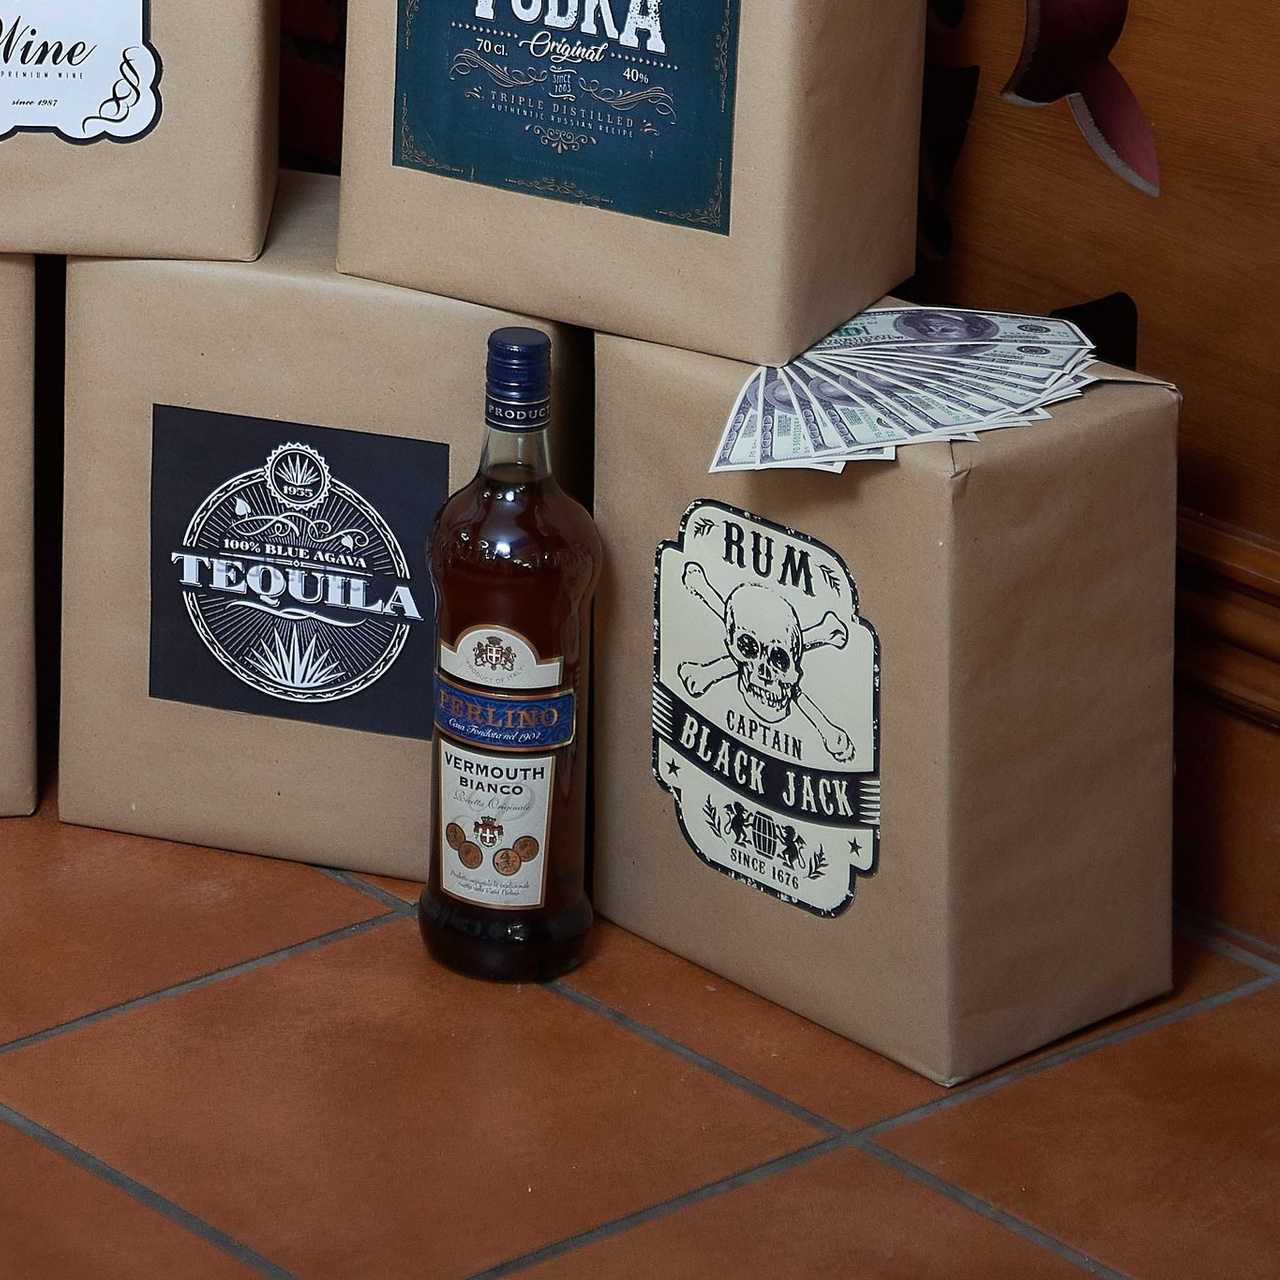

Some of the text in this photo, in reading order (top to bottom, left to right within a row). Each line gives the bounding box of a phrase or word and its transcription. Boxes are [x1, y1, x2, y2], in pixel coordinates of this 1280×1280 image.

[476, 38, 492, 54] 70
[519, 31, 609, 63] Original
[1, 71, 83, 80] PREMIUM WINE
[623, 67, 649, 84] 40%
[12, 99, 58, 108] since 1987
[490, 91, 634, 127] TRIPLE DISTILLED
[491, 104, 633, 138] AUTHENTIC RUSSIAN RECIPE
[282, 484, 313, 498] 1955
[223, 538, 367, 568] 100% BLUE AGAVA
[722, 520, 816, 597] RUM
[171, 552, 424, 621] TEQUILA
[466, 660, 493, 683] PRODUCT
[439, 689, 558, 729] PERLINO
[727, 710, 804, 761] CAPTAIN
[445, 751, 545, 781] VERMOUTH
[679, 713, 854, 817] BLACK JACK
[459, 776, 524, 795] BIANCO
[730, 848, 799, 890] SINCE 1676
